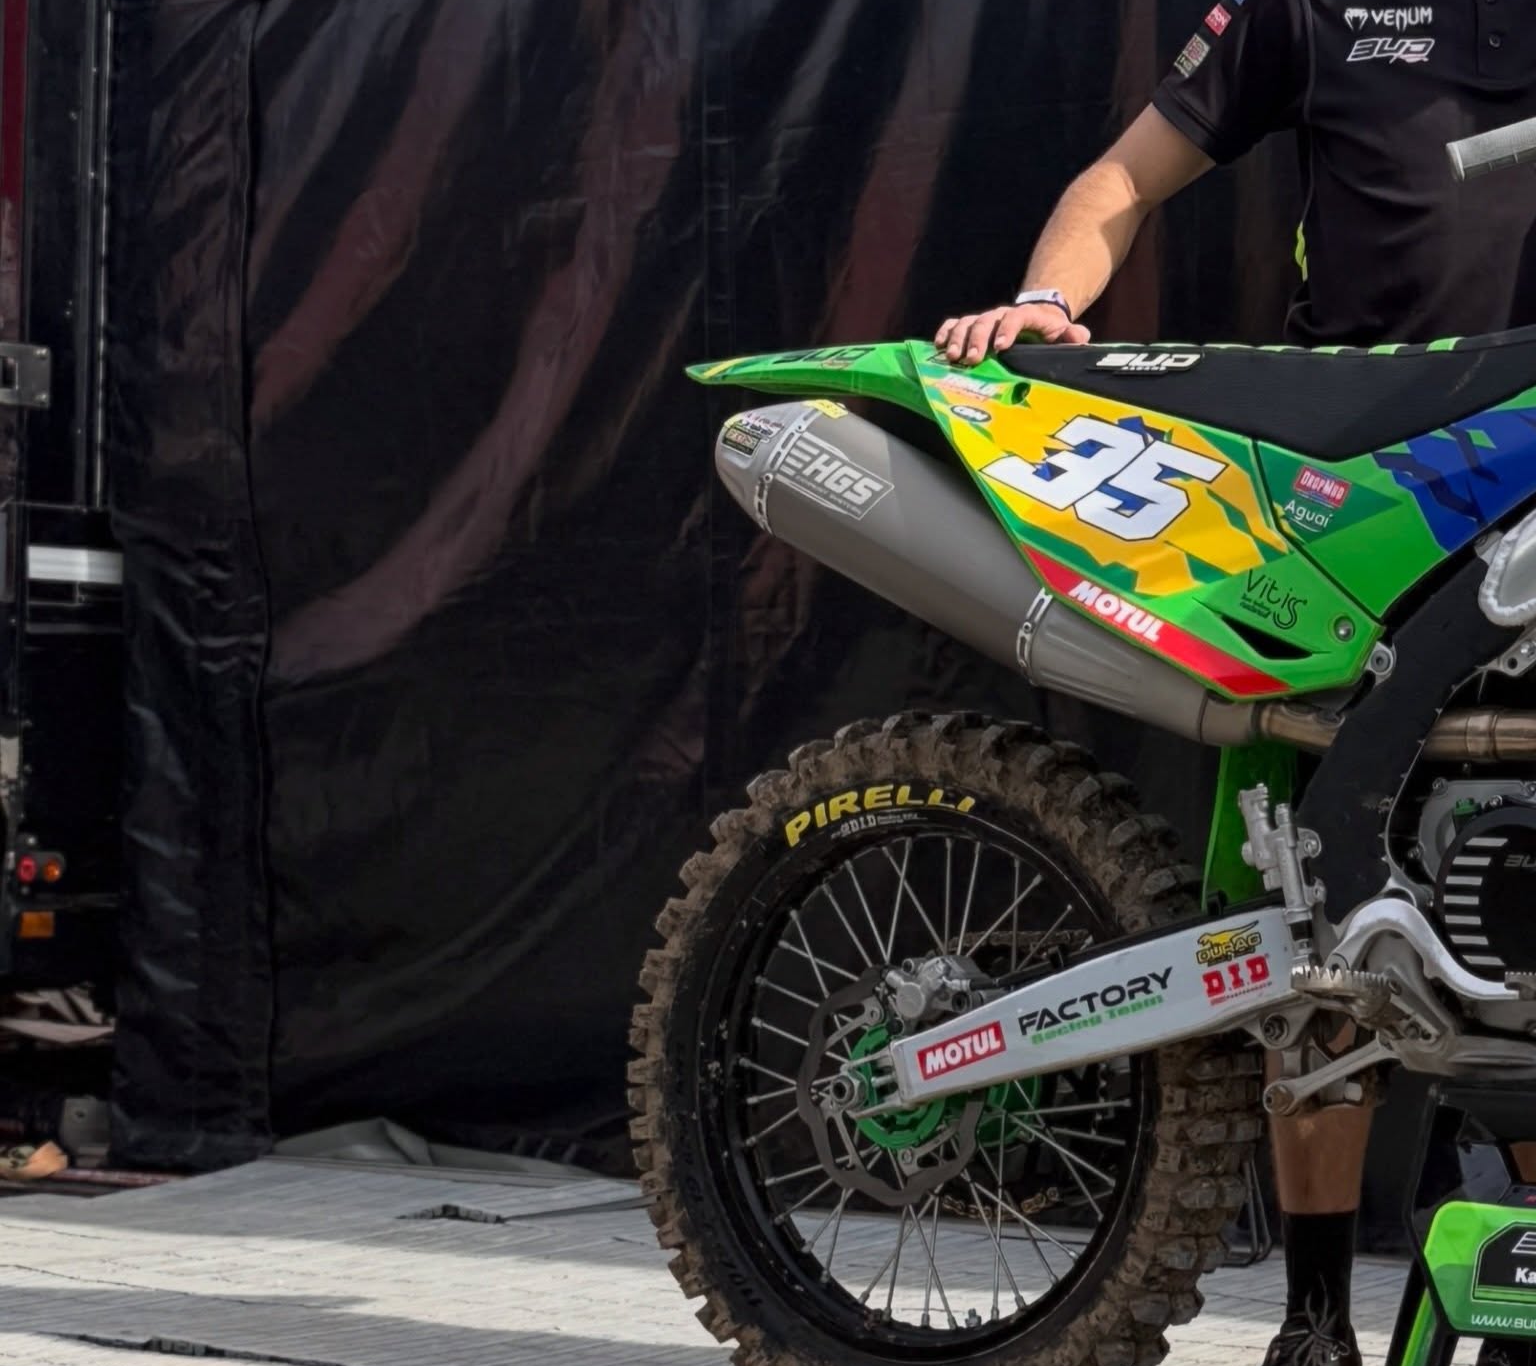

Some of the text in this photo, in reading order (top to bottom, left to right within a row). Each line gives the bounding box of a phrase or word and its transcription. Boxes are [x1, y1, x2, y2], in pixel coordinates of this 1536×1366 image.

[1371, 7, 1433, 31] VENUM
[1096, 352, 1200, 367] BUD
[802, 453, 883, 505] HGS
[979, 414, 1228, 541] 35
[1068, 581, 1167, 642] MOTUL
[784, 784, 975, 847] PIRELLI
[1018, 966, 1173, 1036] FACTORY
[1031, 994, 1164, 1045] Racing Team
[924, 1025, 1001, 1075] MOTUL
